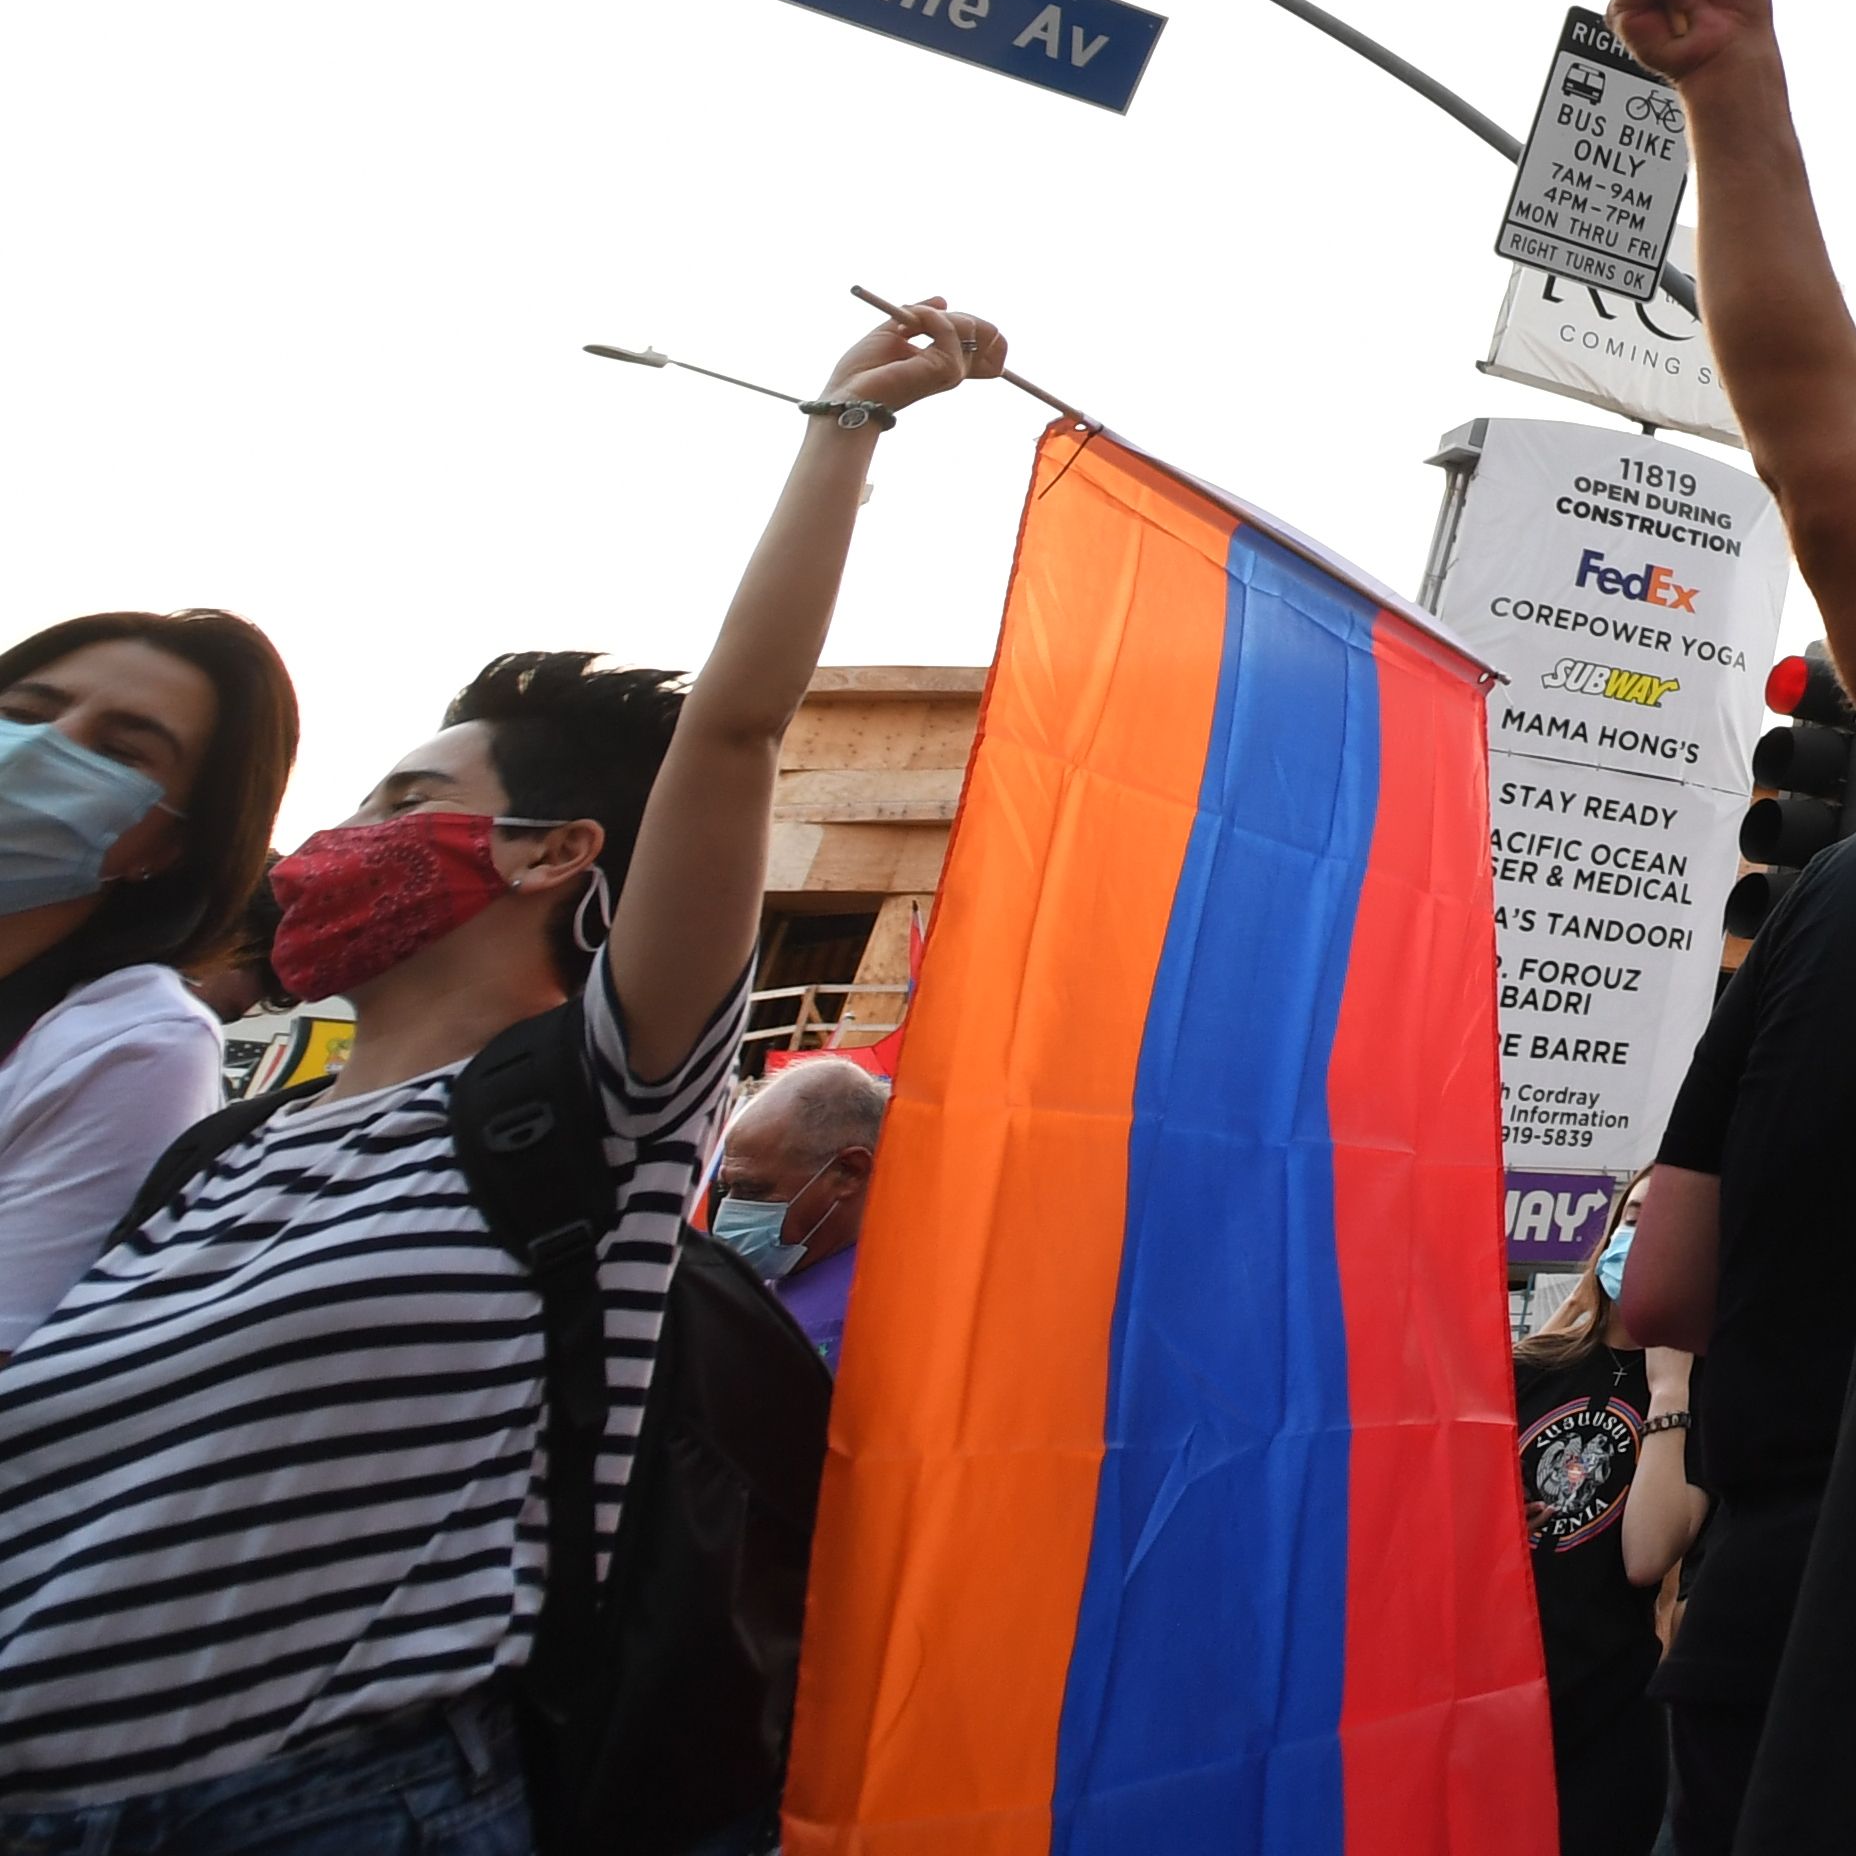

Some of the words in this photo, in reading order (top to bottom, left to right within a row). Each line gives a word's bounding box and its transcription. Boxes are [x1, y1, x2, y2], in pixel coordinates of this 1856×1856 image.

[1012, 4, 1110, 70] Av
[1572, 22, 1634, 61] RIGH
[1557, 103, 1607, 138] BUS
[1619, 124, 1675, 162] BIKE
[1574, 139, 1646, 180] ONLY
[1516, 200, 1557, 230] MON
[1570, 218, 1618, 249] THRU
[1627, 235, 1658, 262] FRI
[1509, 233, 1557, 264] RIGHT
[1565, 250, 1616, 282] TURNS
[1623, 270, 1646, 290] OK
[1560, 323, 1681, 376] COMING
[1618, 456, 1697, 497] 11819
[1555, 496, 1742, 558] CONSTRUCTION
[1573, 475, 1640, 507] OPEN
[1645, 492, 1733, 531] DURING
[1574, 547, 1700, 614] FedEx
[1489, 596, 1673, 653] COREPOWER
[1681, 636, 1748, 673] YOGA
[1541, 657, 1681, 708] SUBWAY
[1501, 708, 1589, 744] MAMA
[1599, 724, 1700, 765] HONG'S
[1499, 782, 1578, 815] STAY
[1583, 795, 1678, 831] READY
[1489, 828, 1583, 862] ACIFIC
[1590, 843, 1688, 878] OCEAN
[1546, 864, 1564, 887] &
[1573, 868, 1693, 905] MEDICAL
[1493, 905, 1537, 932] A'S
[1547, 912, 1693, 952] TANDOORI
[1518, 957, 1643, 992] FOROUZ
[1529, 1035, 1630, 1065] BARRE
[1509, 1105, 1630, 1130] Information
[1517, 1083, 1601, 1110] Cordray
[1542, 1498, 1609, 1535] ENIA
